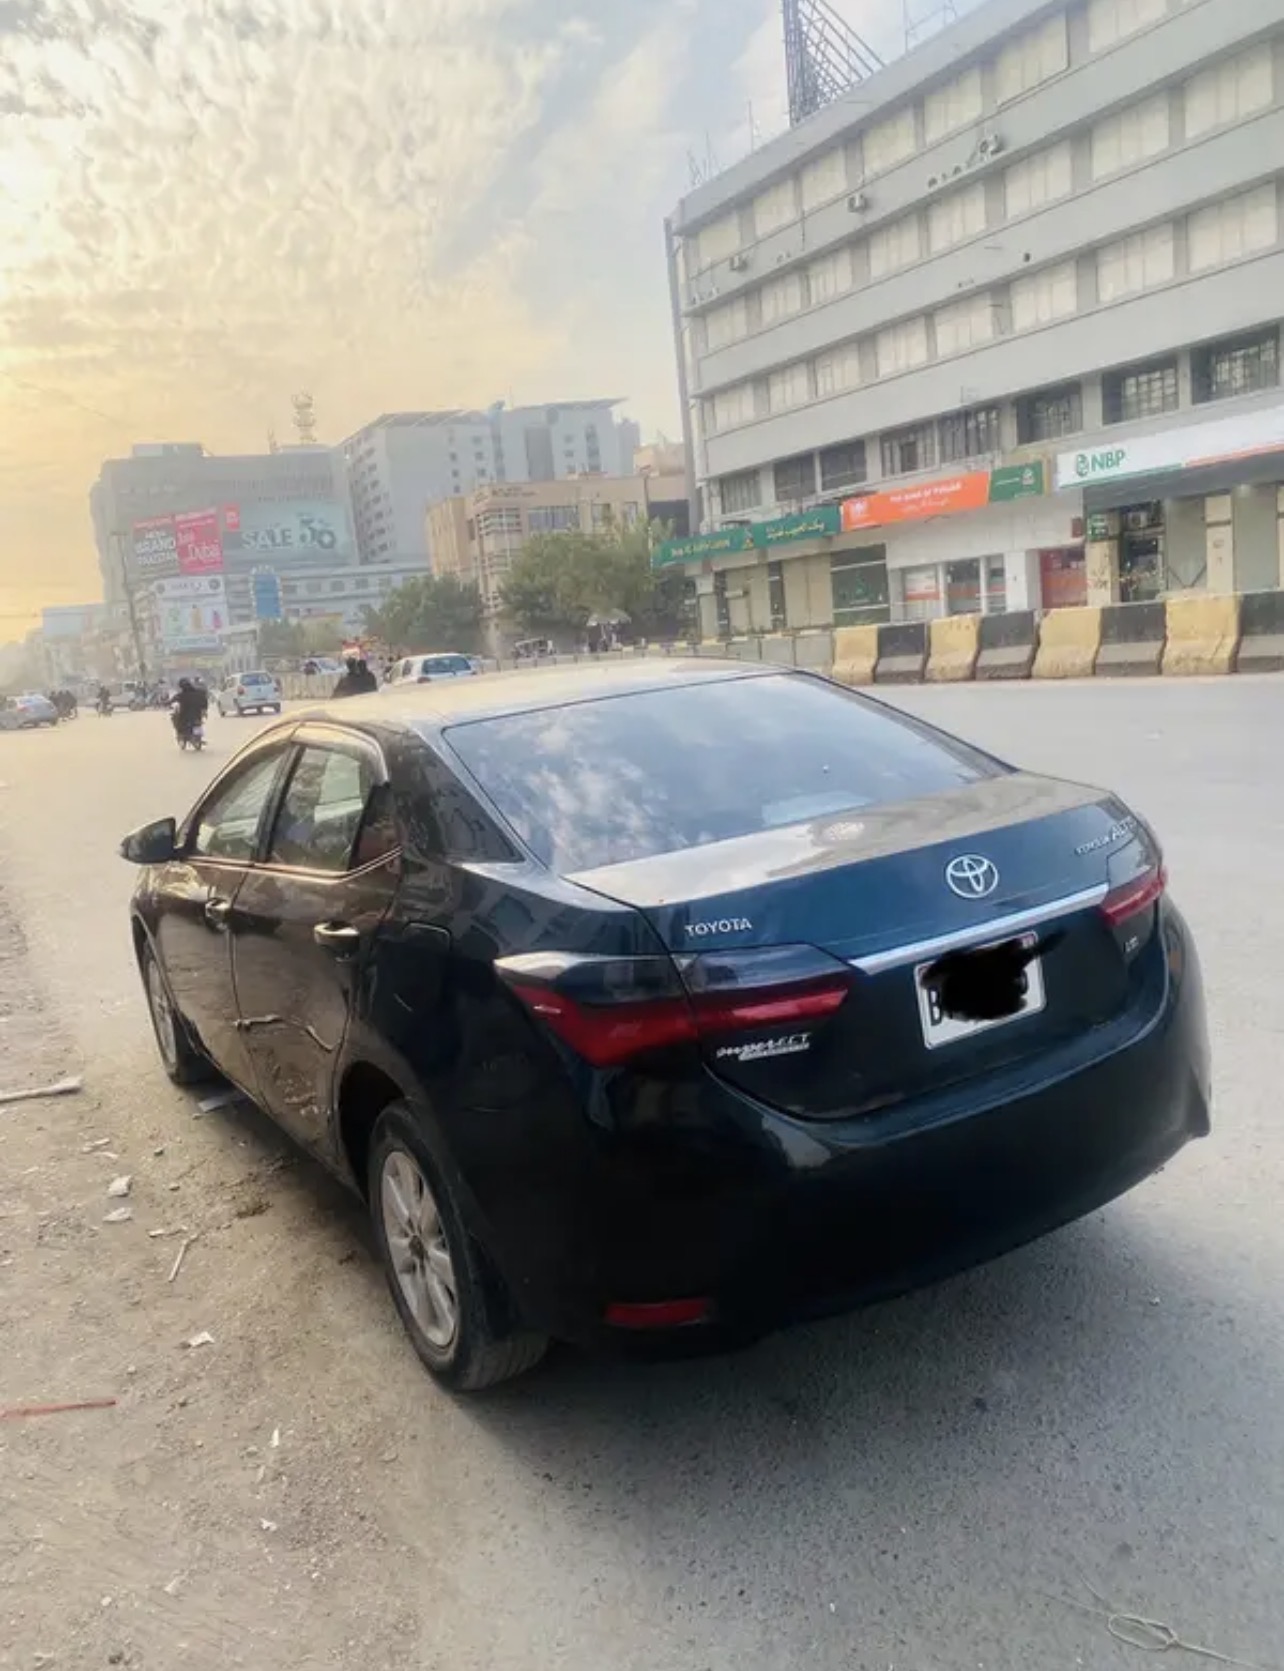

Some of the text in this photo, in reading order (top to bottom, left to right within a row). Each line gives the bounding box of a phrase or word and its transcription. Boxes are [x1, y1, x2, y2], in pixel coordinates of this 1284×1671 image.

[1090, 449, 1126, 472] NBP
[241, 528, 293, 551] SALE
[684, 917, 753, 937] TOYOTA
